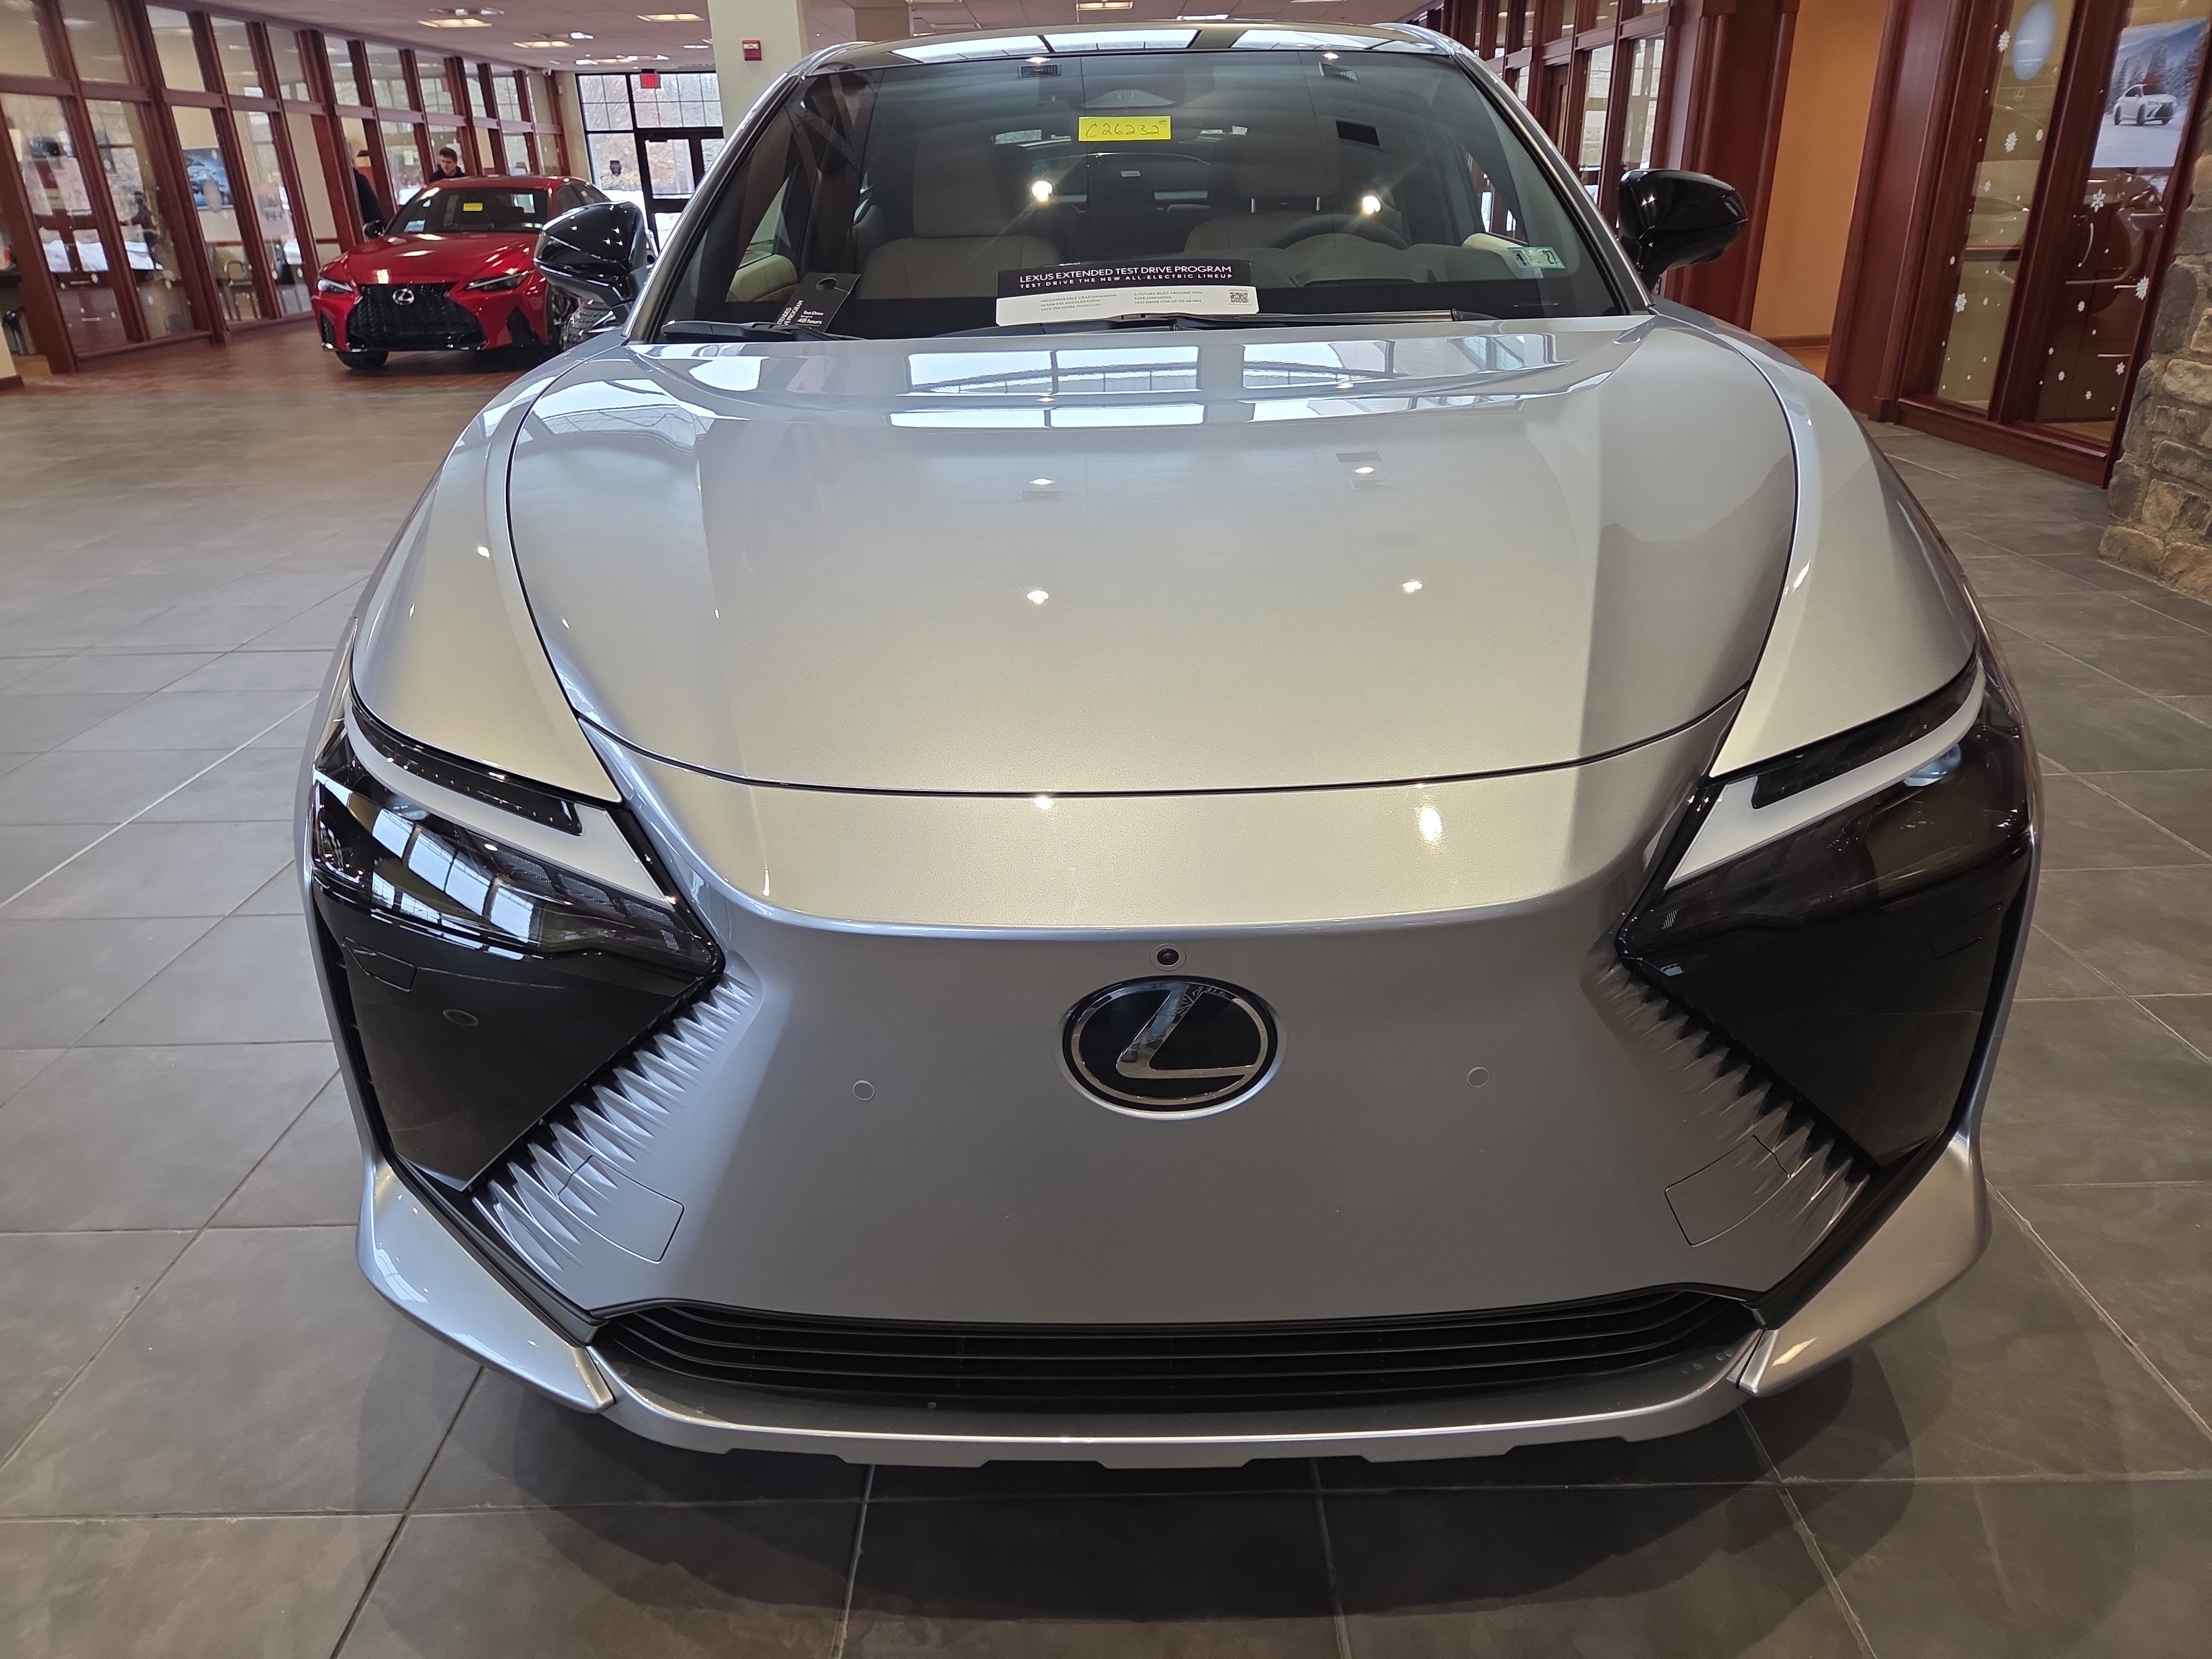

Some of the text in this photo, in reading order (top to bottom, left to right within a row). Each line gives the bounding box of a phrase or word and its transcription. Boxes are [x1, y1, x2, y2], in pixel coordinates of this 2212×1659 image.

[1086, 123, 1159, 138] C26232
[1020, 273, 1054, 283] LEXUS
[1056, 268, 1113, 279] EXTENDED
